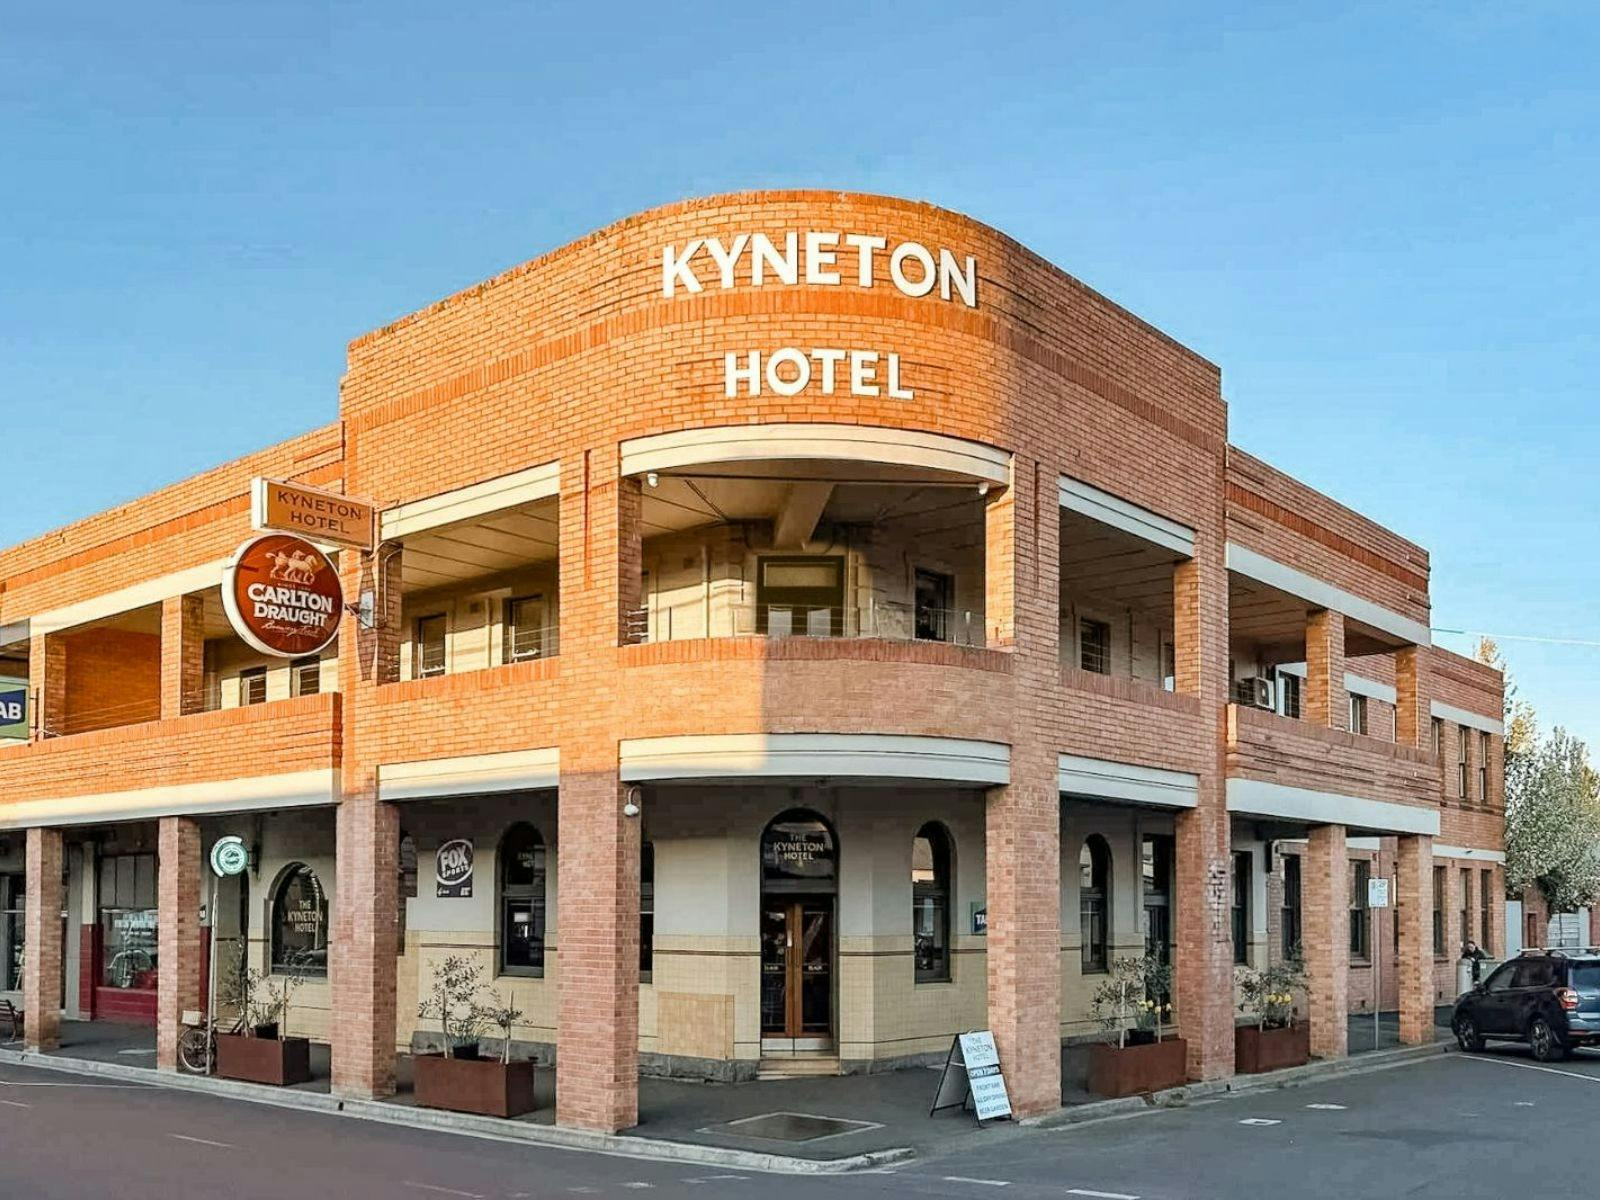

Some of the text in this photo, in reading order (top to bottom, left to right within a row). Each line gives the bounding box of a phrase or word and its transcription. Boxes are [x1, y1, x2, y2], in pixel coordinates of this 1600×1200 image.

[663, 231, 978, 308] KYNETON
[724, 347, 915, 400] HOTEL
[278, 491, 362, 520] KYNETON
[291, 511, 350, 534] HOTEL
[247, 582, 333, 613] CARLTON
[253, 602, 328, 627] DRAUGHT
[790, 833, 807, 841] THE
[773, 842, 824, 852] KYNETON
[783, 852, 815, 860] HOTEL
[440, 845, 469, 872] FOX
[442, 863, 470, 879] SPORTS
[299, 900, 311, 910] THE
[287, 911, 323, 922] KYNETON
[294, 922, 317, 933] HOTEL
